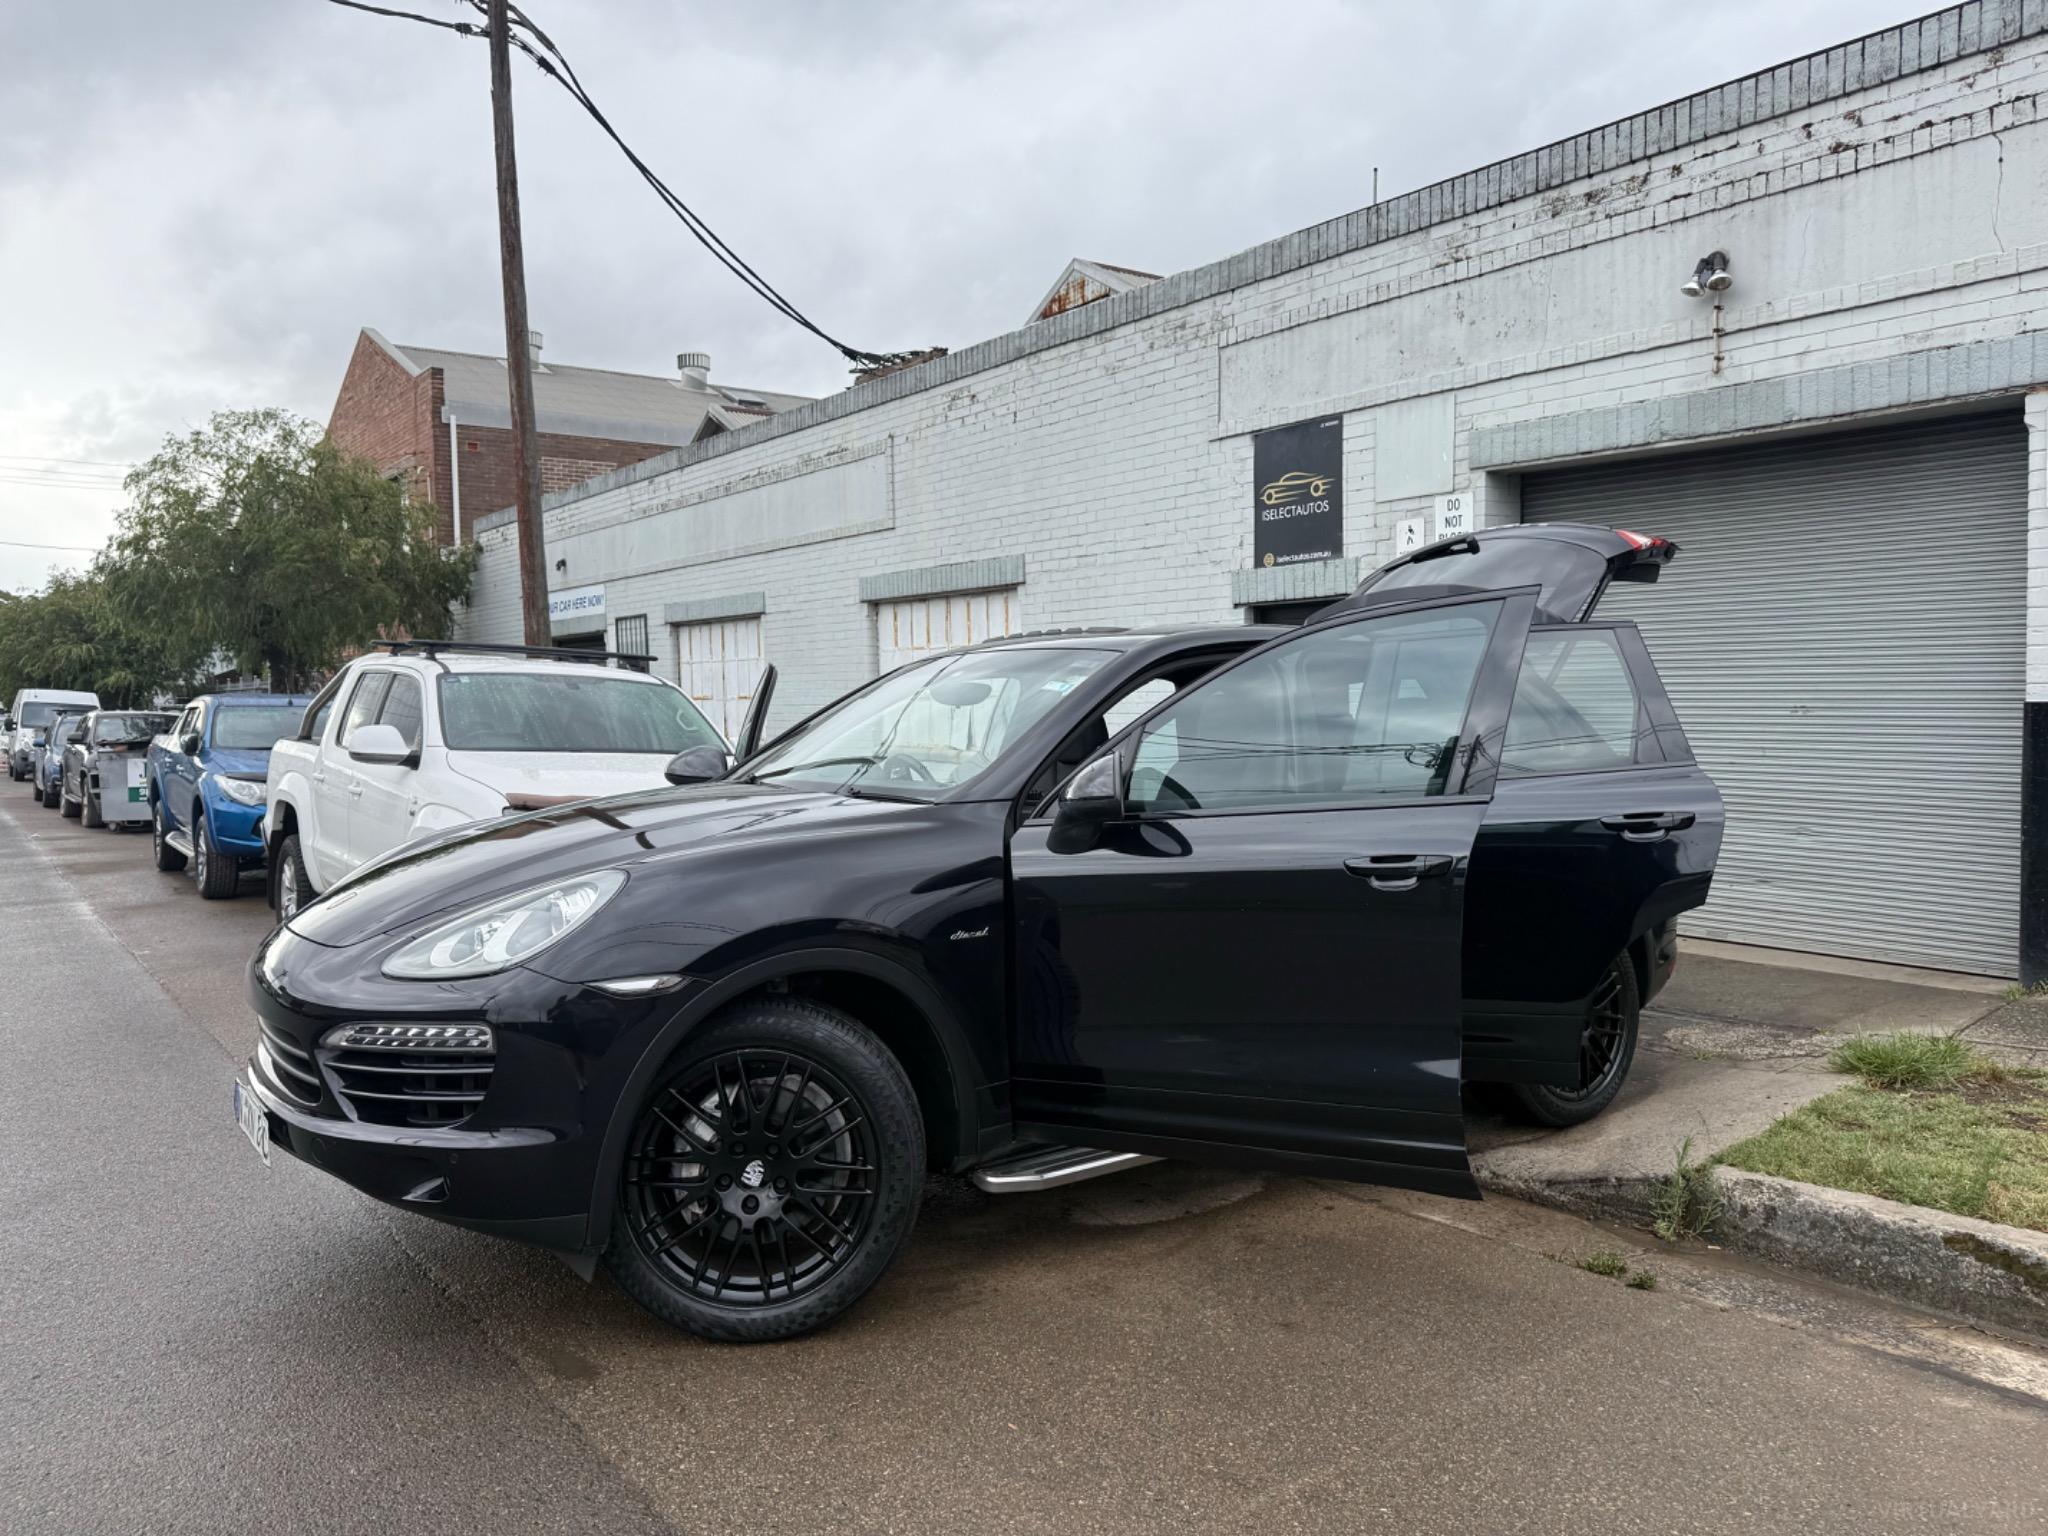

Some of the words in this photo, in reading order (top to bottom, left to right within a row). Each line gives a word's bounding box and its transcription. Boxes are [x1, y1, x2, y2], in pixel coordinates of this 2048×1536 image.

[1447, 498, 1460, 512] DO
[1445, 515, 1463, 529] NOT
[549, 600, 558, 613] UR
[559, 599, 571, 612] CAR
[572, 596, 587, 609] HERE
